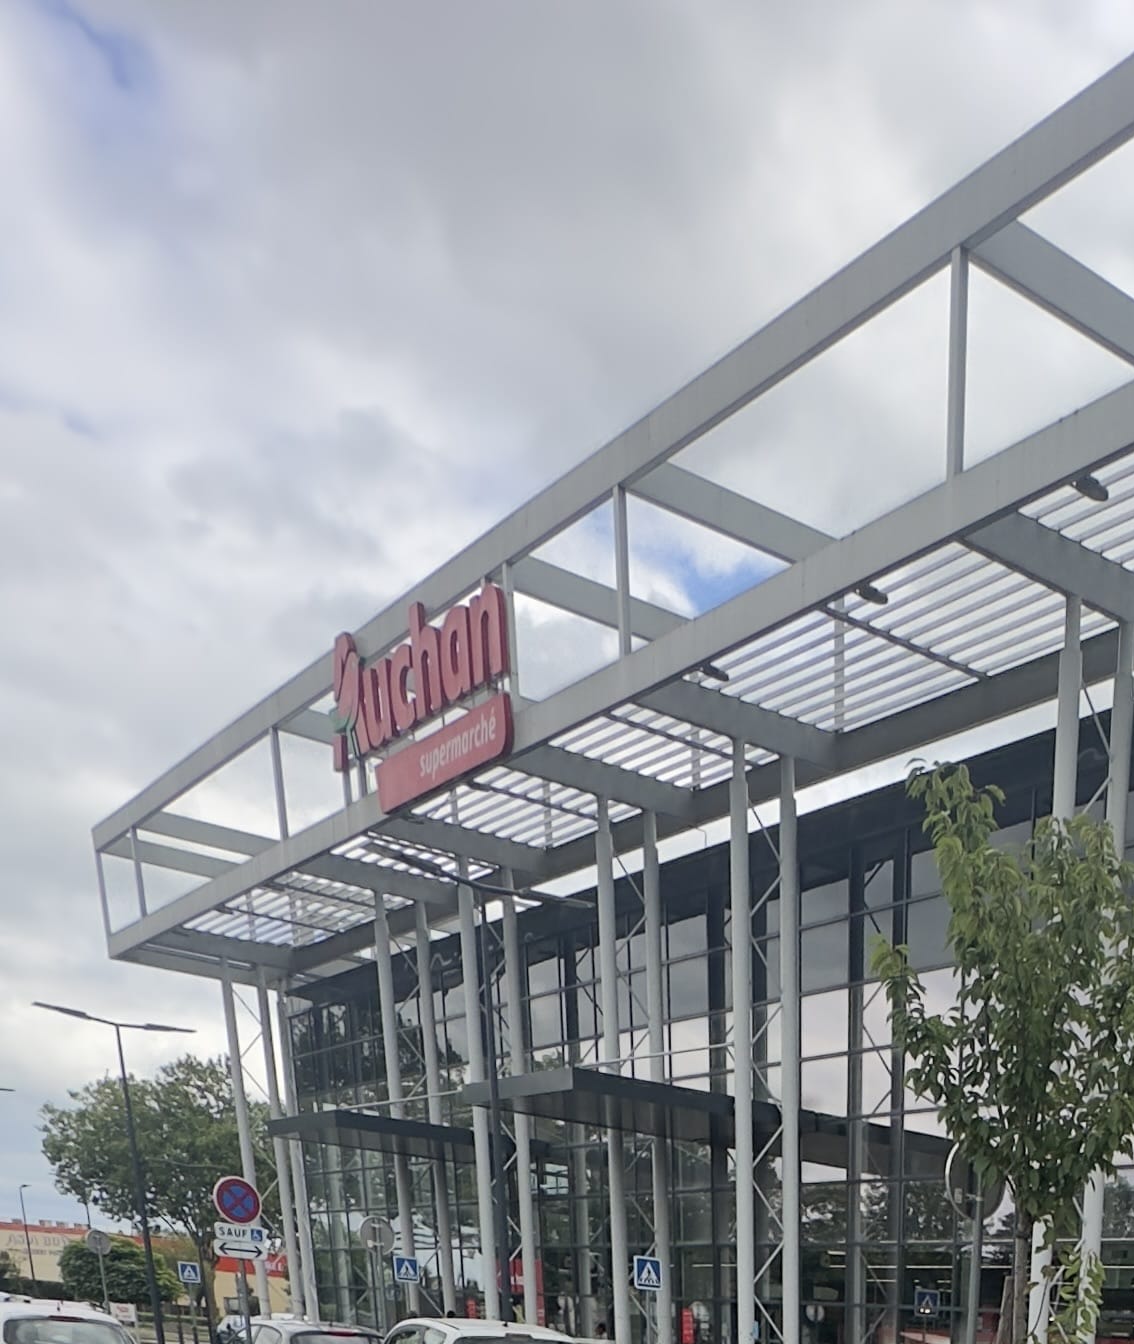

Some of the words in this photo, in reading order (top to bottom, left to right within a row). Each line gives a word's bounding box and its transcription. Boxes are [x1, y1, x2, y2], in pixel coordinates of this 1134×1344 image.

[333, 581, 507, 772] Auchan
[419, 707, 497, 780] supermarché
[218, 1226, 248, 1238] SAUF
